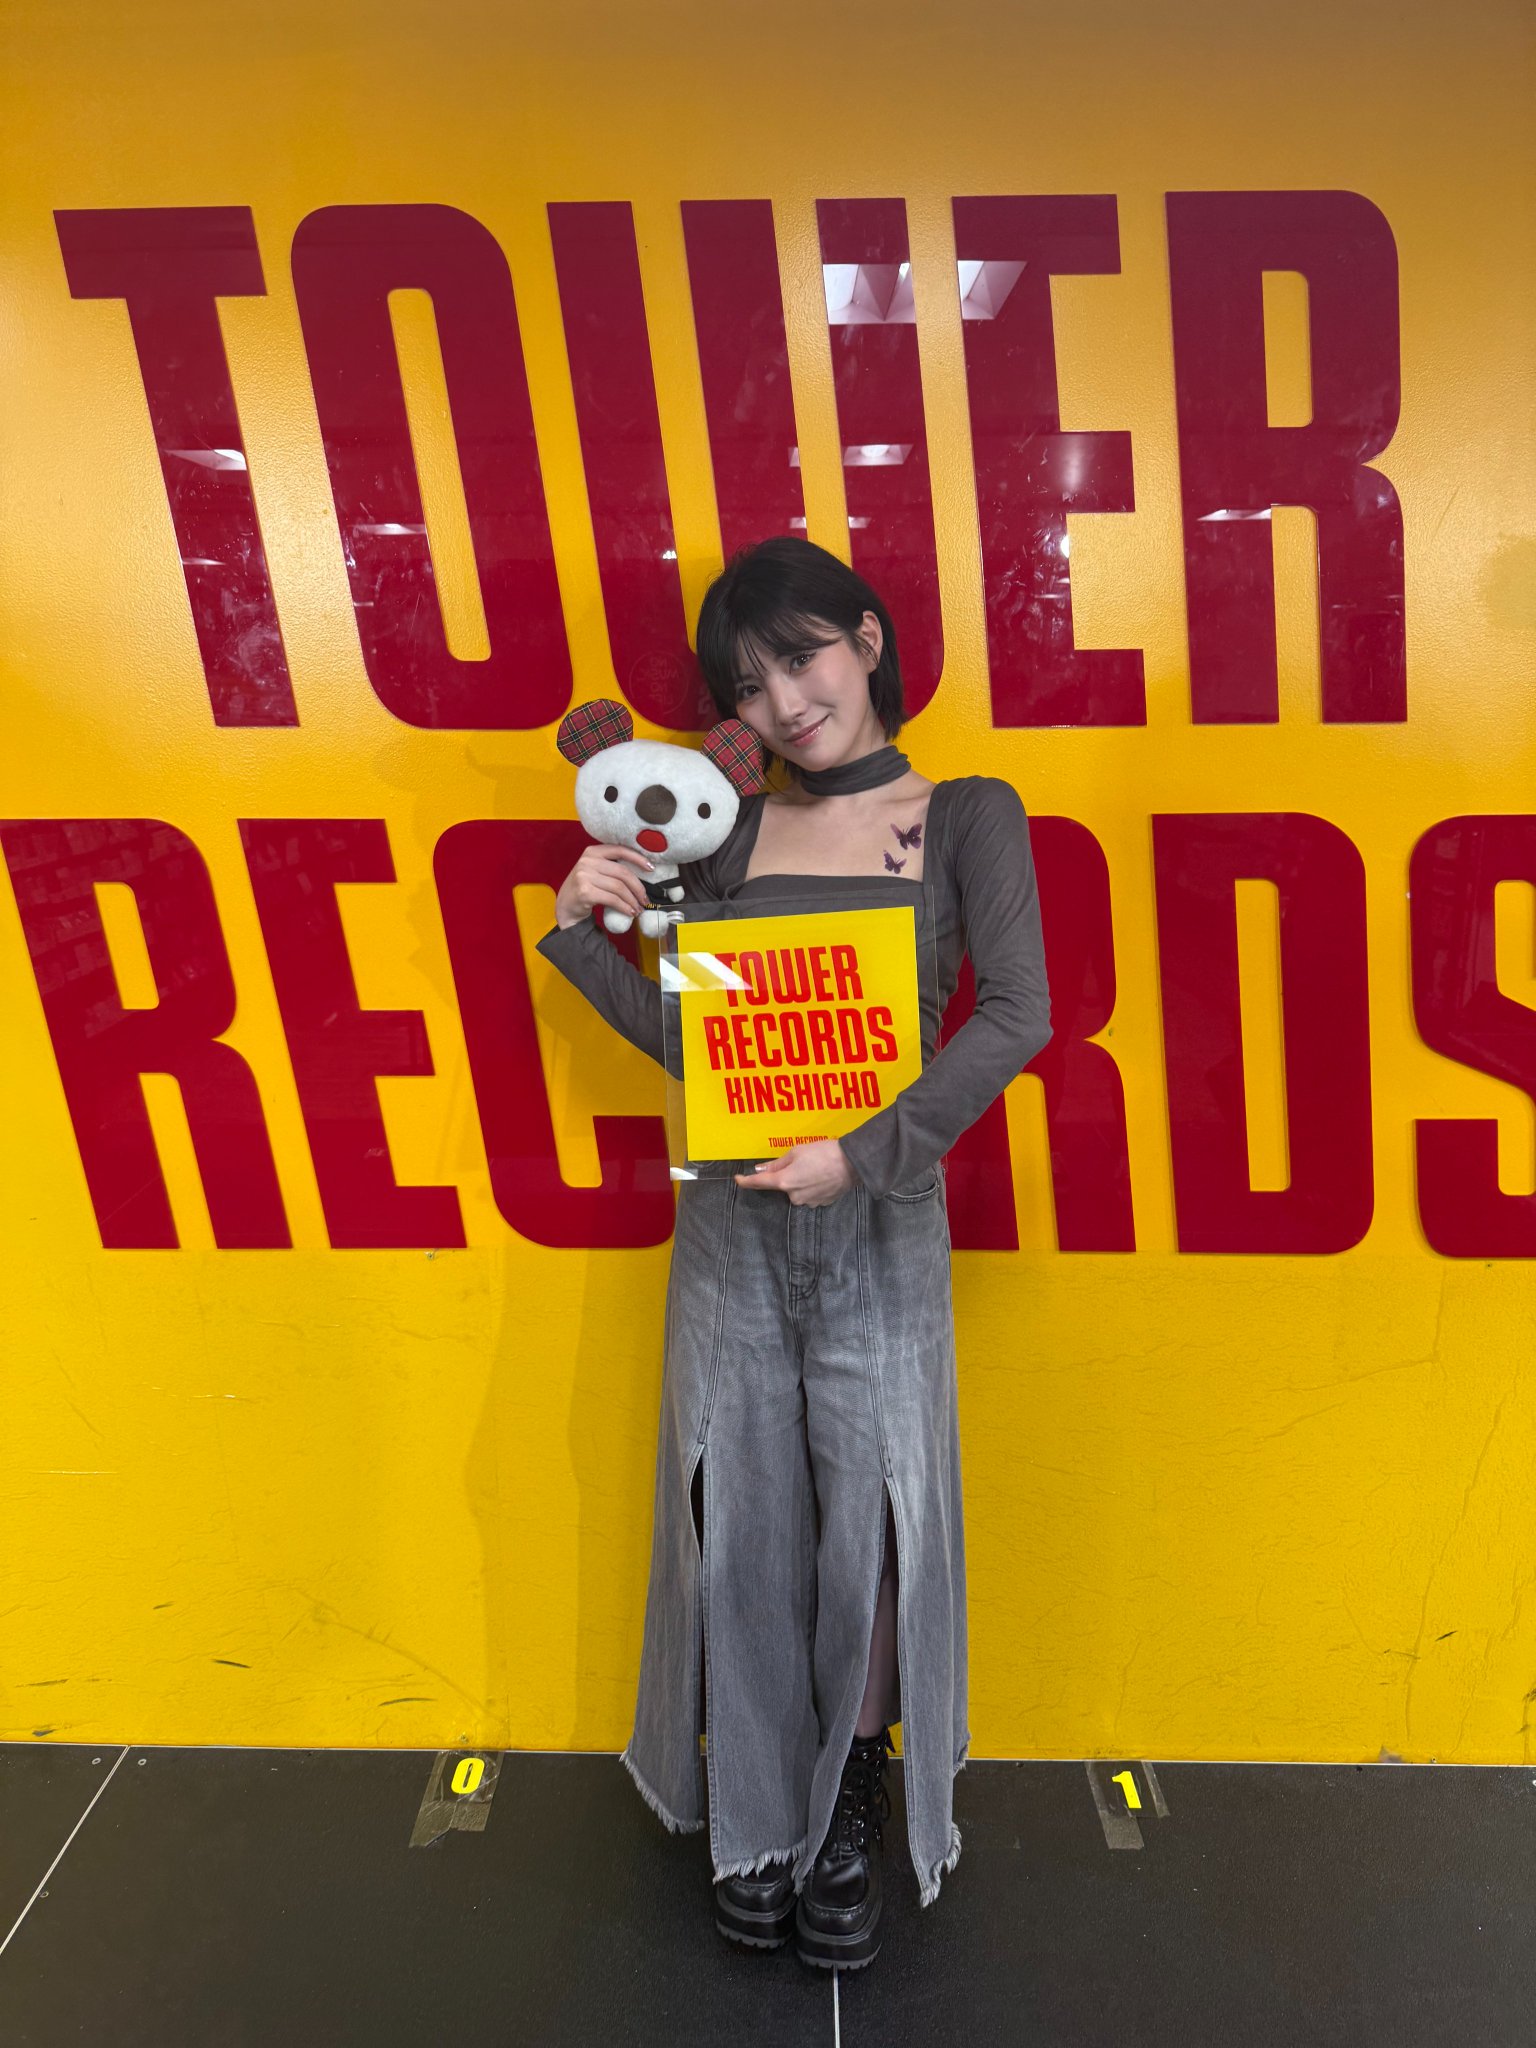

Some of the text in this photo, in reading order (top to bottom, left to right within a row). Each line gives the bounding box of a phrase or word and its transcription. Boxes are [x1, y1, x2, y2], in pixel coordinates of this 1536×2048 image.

[53, 190, 1408, 729] TOWER
[714, 944, 864, 1008] TOWER
[0, 812, 1536, 1258] RECRDS
[703, 1006, 899, 1071] RECORDS
[724, 1071, 882, 1114] KINSHICHO
[768, 1136, 794, 1148] TOWER
[1112, 1770, 1142, 1809] 1
